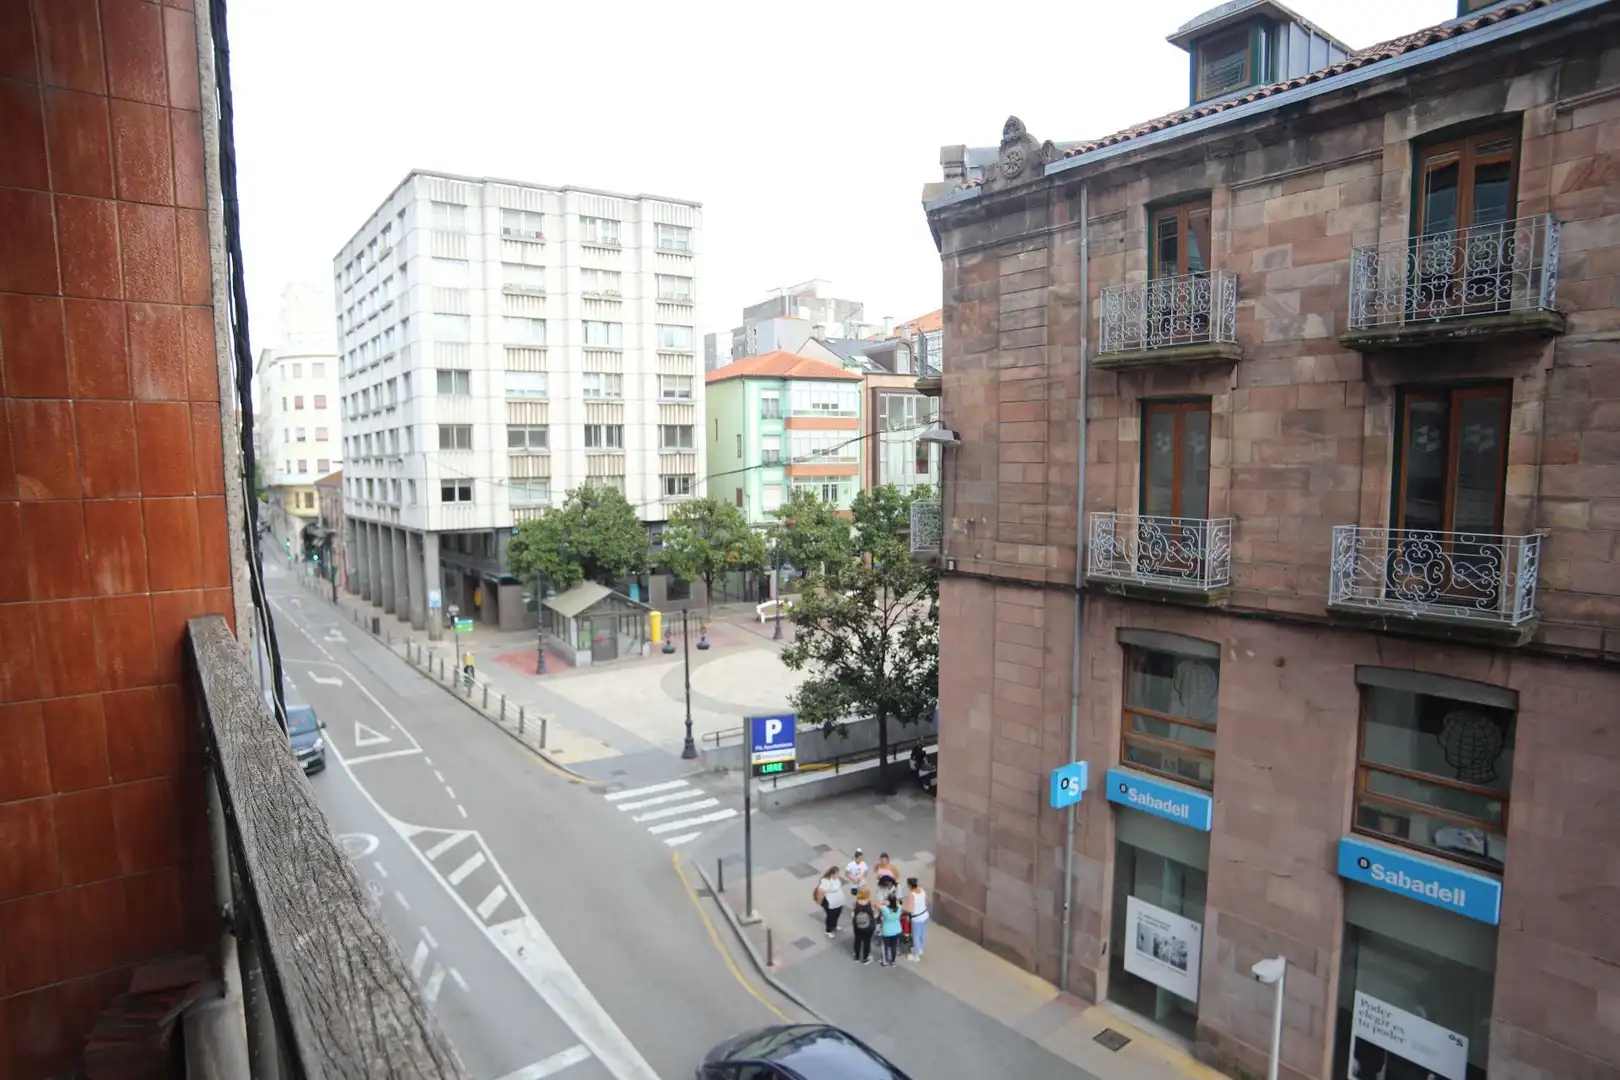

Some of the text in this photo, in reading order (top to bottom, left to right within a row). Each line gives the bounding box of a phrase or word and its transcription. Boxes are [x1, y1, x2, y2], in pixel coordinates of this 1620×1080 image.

[765, 719, 783, 744] P
[762, 762, 783, 773] LIBRE
[1127, 787, 1190, 819] Sabadell
[1371, 862, 1466, 908] Sabadell
[1360, 998, 1392, 1018] Poder
[1358, 1009, 1406, 1035] elegir es
[1358, 1018, 1407, 1045] tu poder
